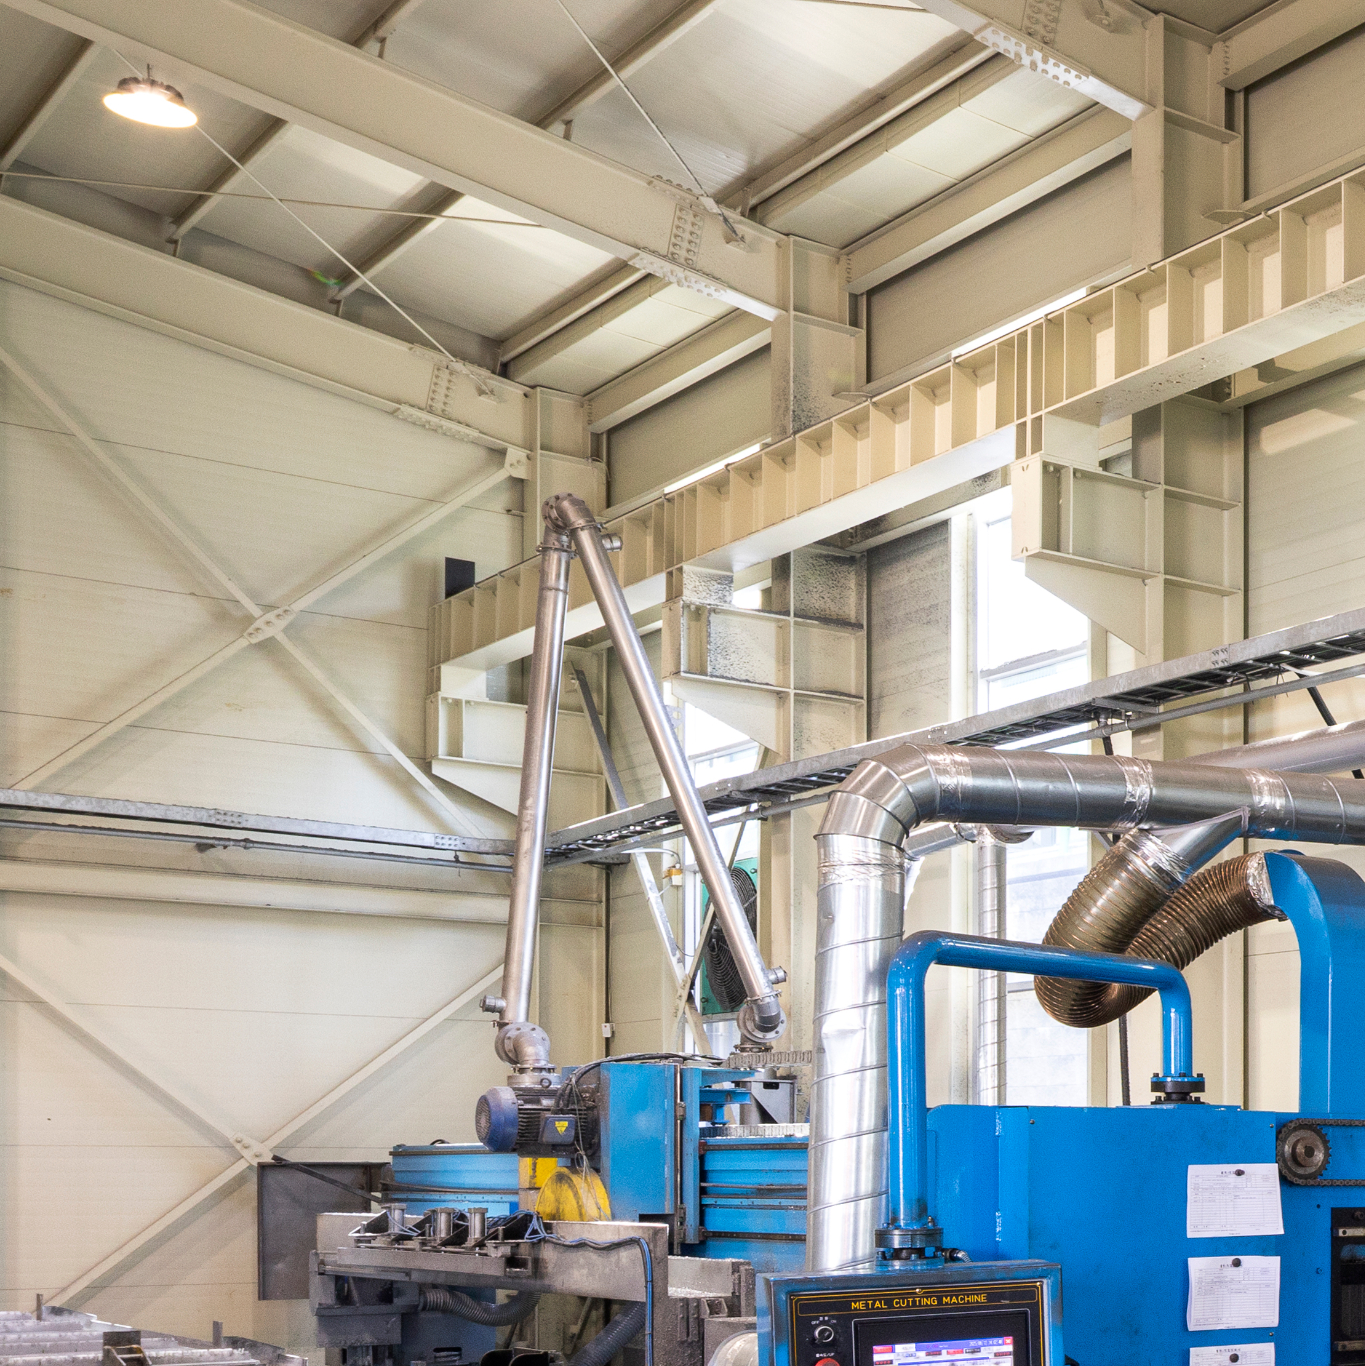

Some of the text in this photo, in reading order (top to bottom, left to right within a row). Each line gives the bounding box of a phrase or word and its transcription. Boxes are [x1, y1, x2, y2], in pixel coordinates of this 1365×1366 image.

[851, 1294, 987, 1310] METAL CUTTING MACHINE
